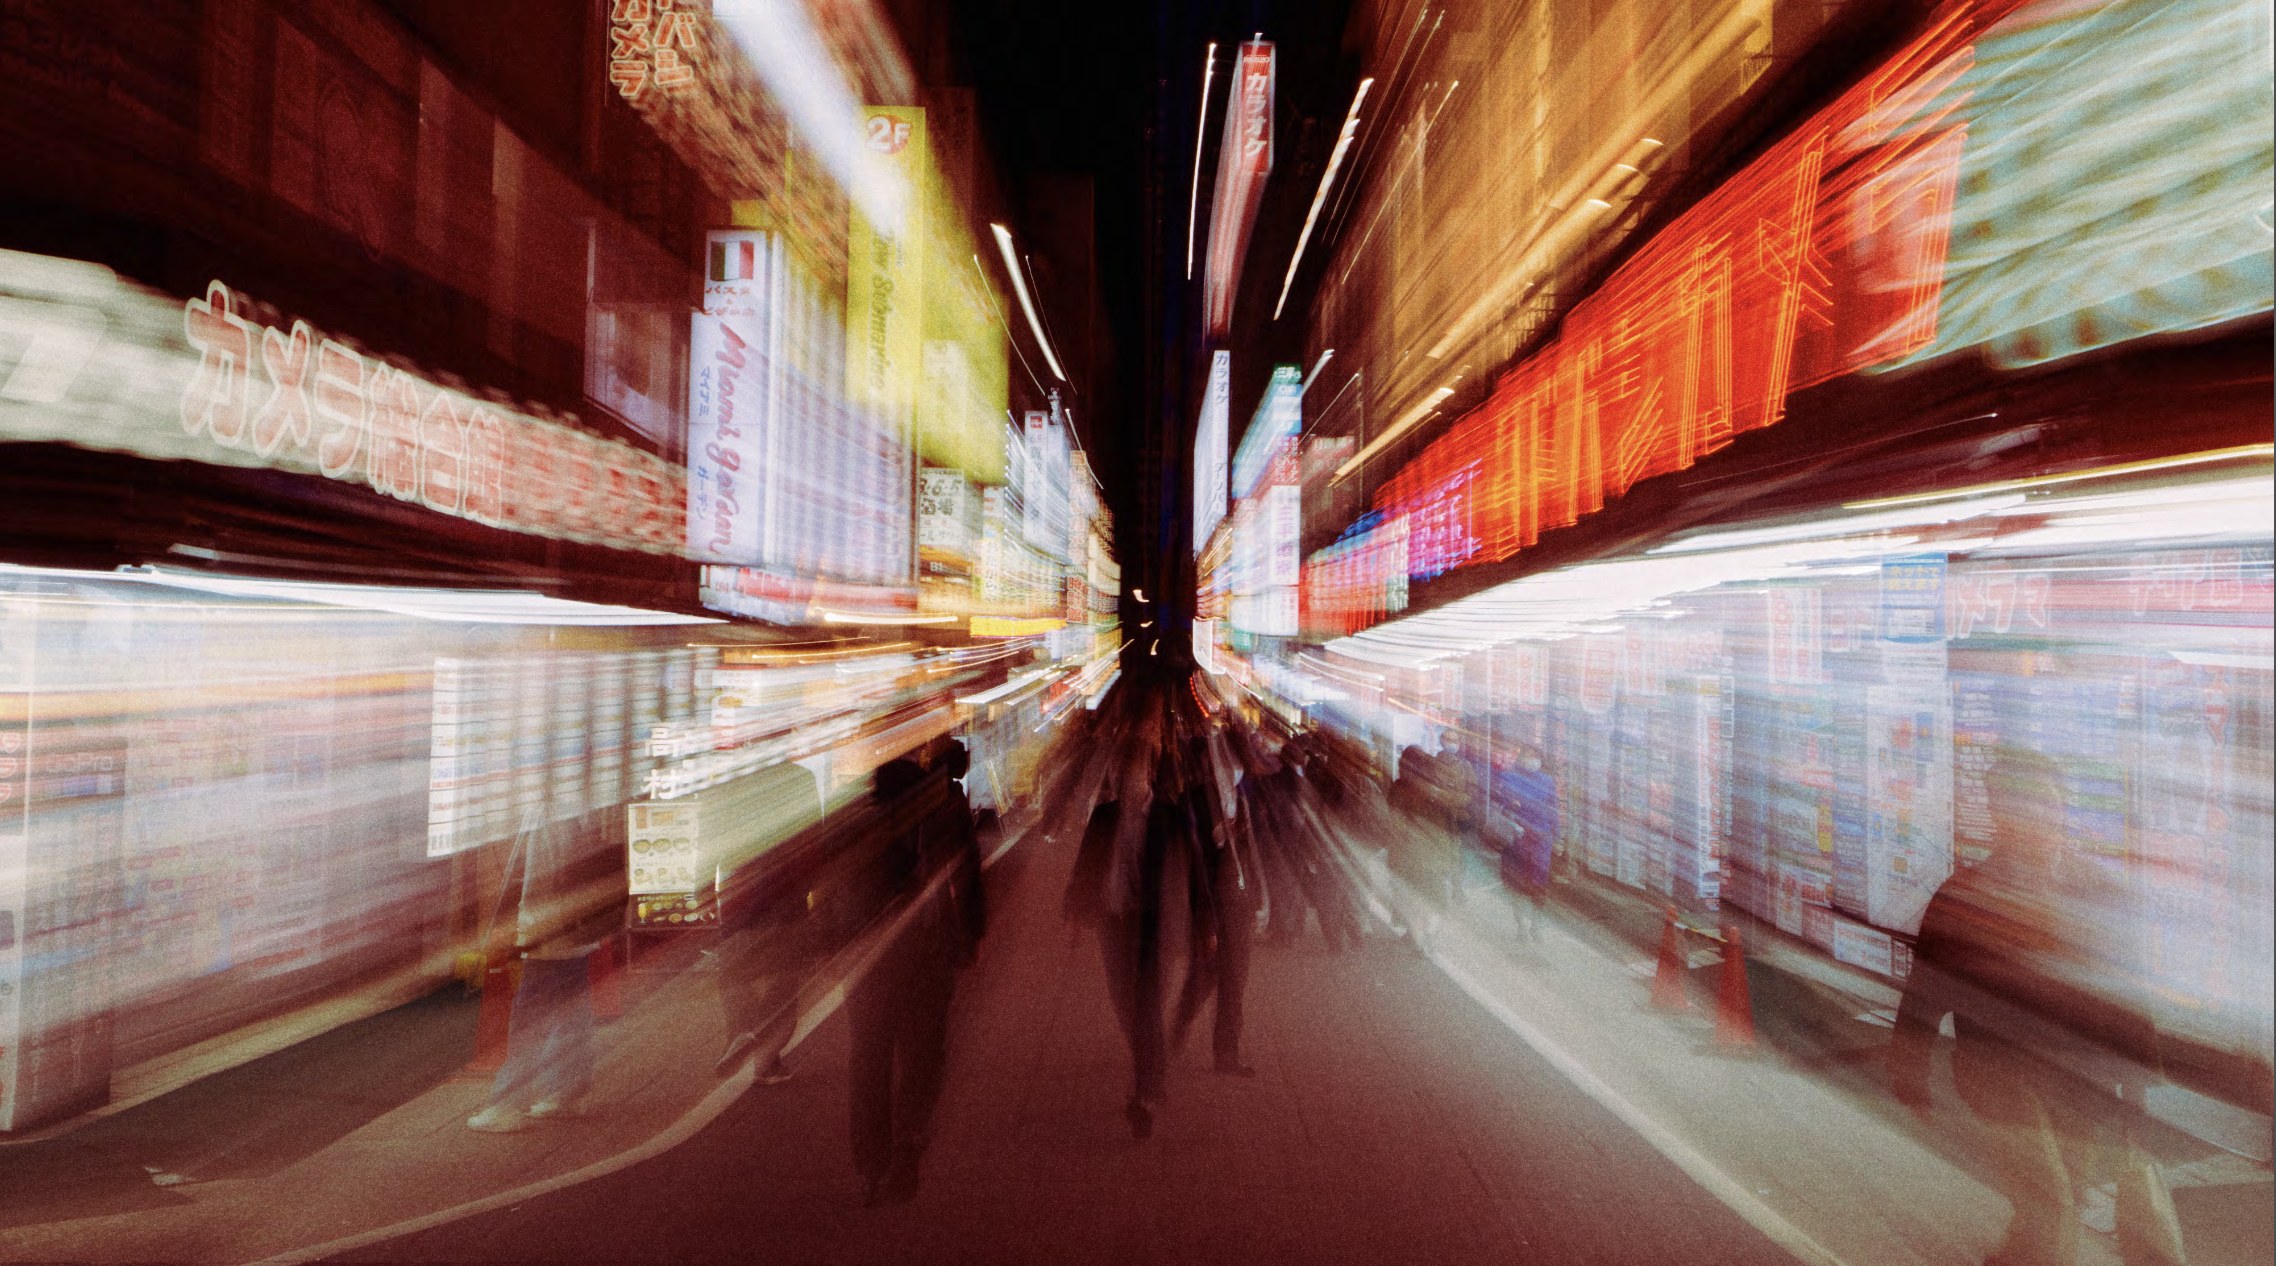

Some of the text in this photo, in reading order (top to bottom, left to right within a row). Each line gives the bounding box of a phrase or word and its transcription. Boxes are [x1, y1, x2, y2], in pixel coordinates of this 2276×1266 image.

[655, 0, 698, 86] バシ
[865, 117, 911, 150] 2F
[1244, 71, 1268, 158] カラオケ
[698, 365, 711, 417] マイアミ
